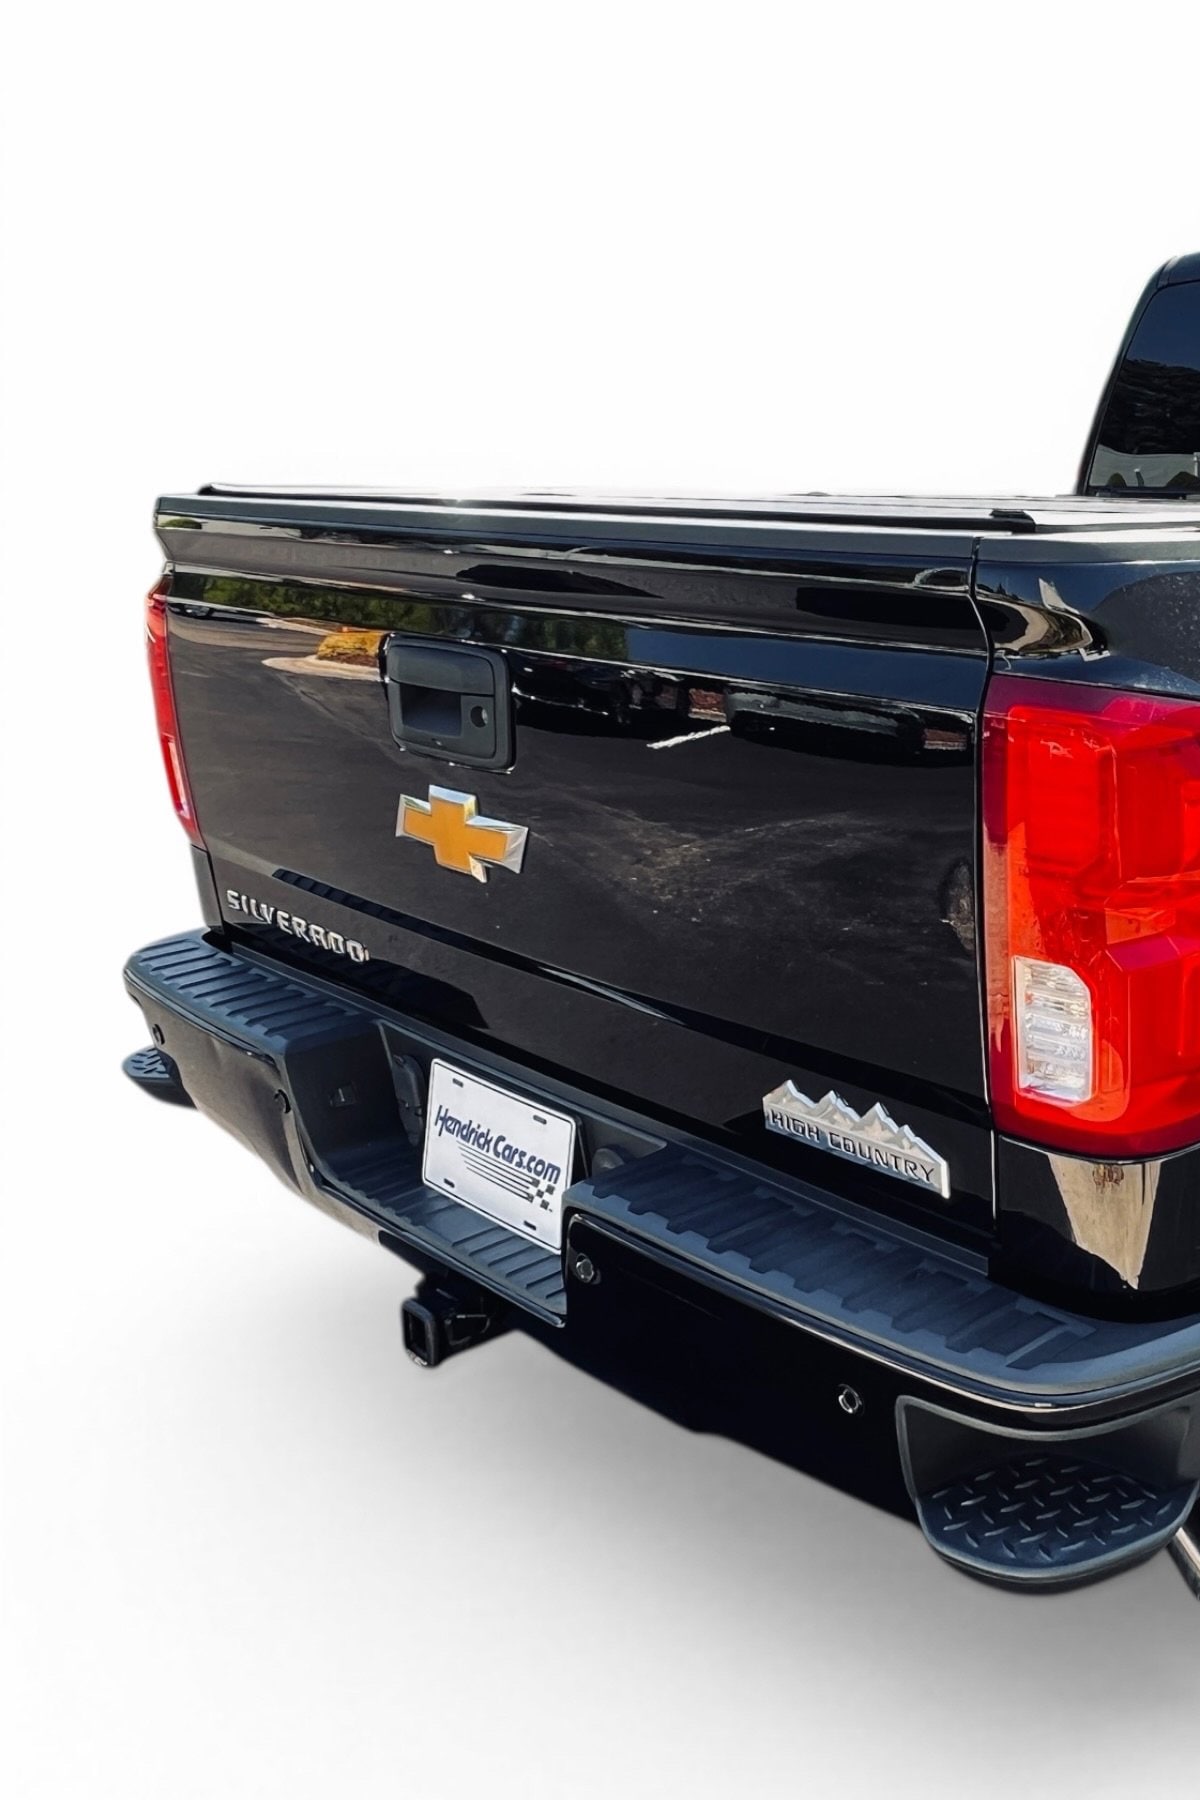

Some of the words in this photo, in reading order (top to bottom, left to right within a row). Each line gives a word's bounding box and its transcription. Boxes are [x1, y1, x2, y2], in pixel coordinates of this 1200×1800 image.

[226, 889, 365, 963] SILVERADO
[769, 1108, 820, 1144] HIGH
[828, 1131, 935, 1182] COUNTRY
